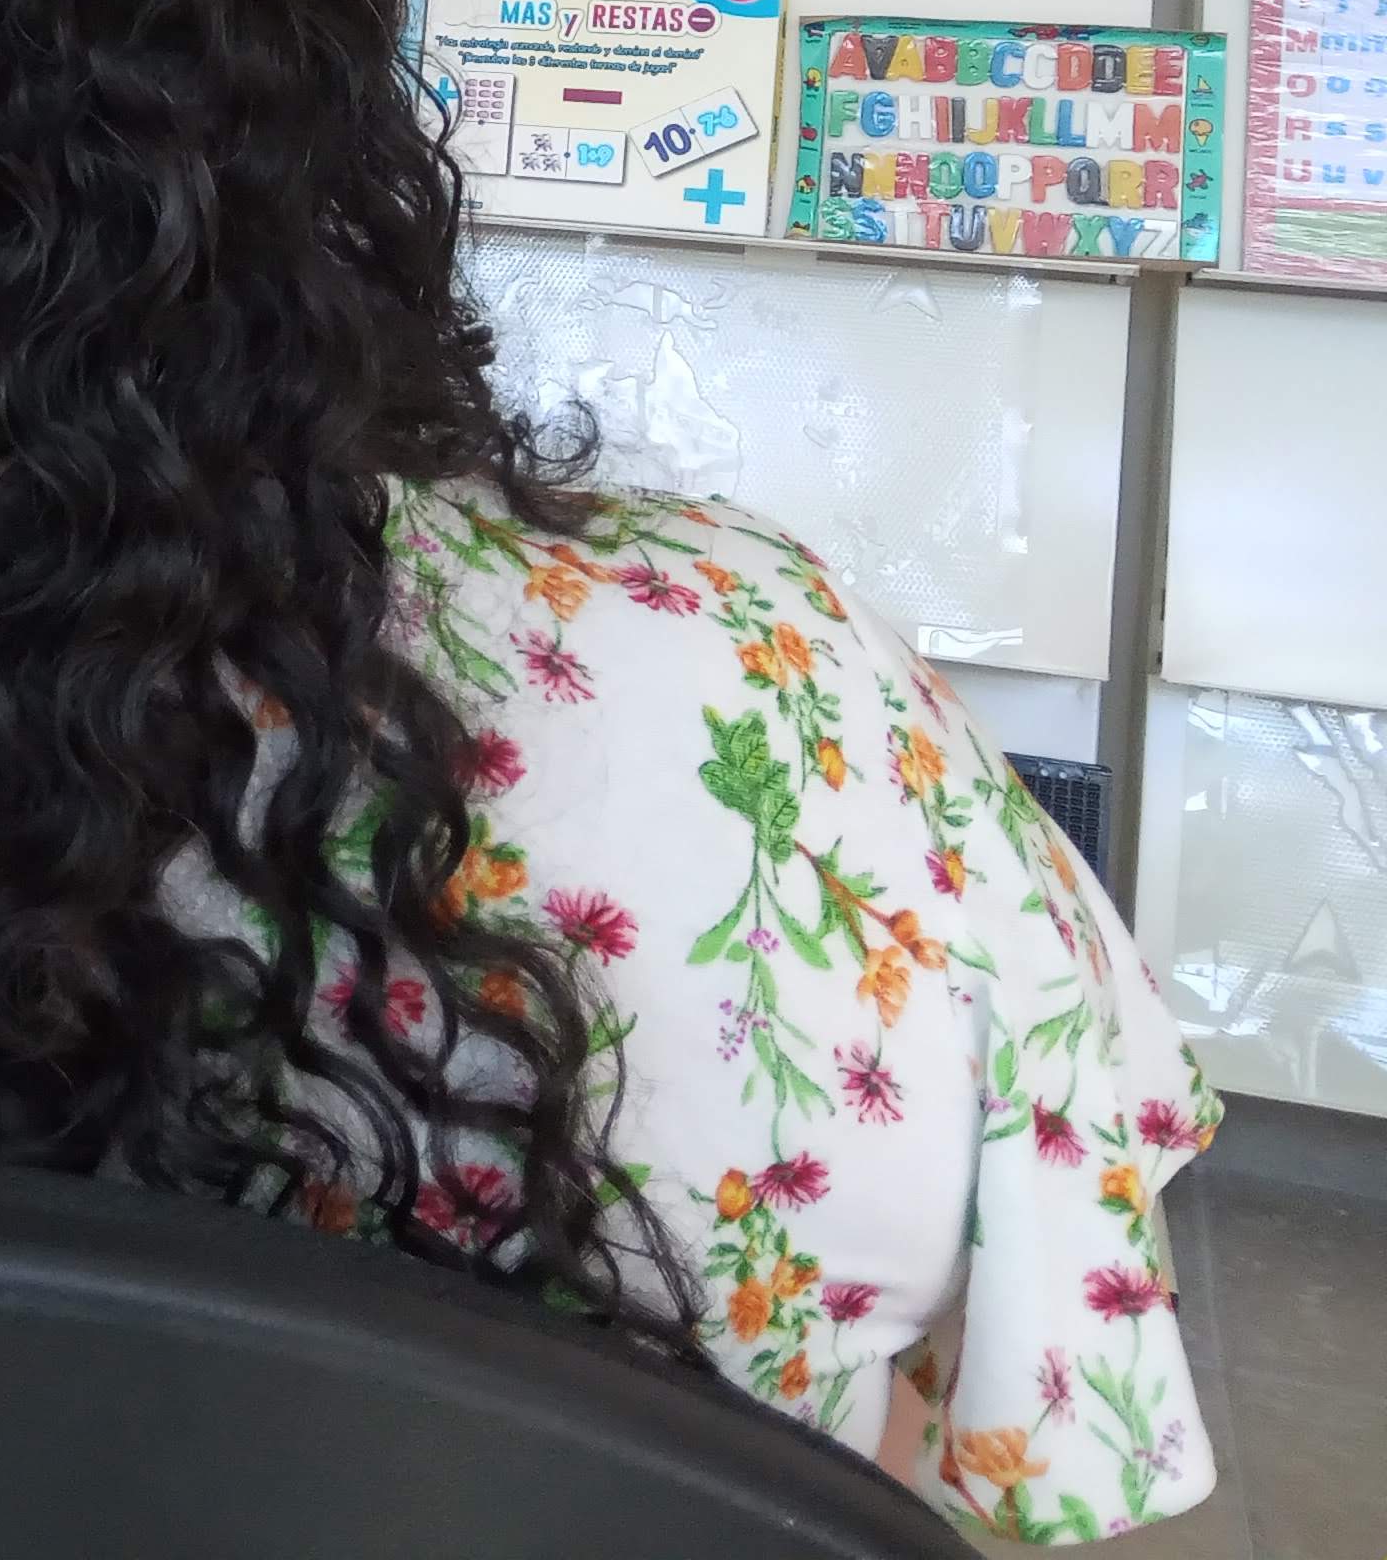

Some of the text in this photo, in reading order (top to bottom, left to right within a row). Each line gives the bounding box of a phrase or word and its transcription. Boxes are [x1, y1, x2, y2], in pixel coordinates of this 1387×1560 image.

[563, 12, 578, 39] y
[591, 4, 684, 33] RESTAS
[1286, 74, 1317, 98] O
[643, 122, 693, 163] 10
